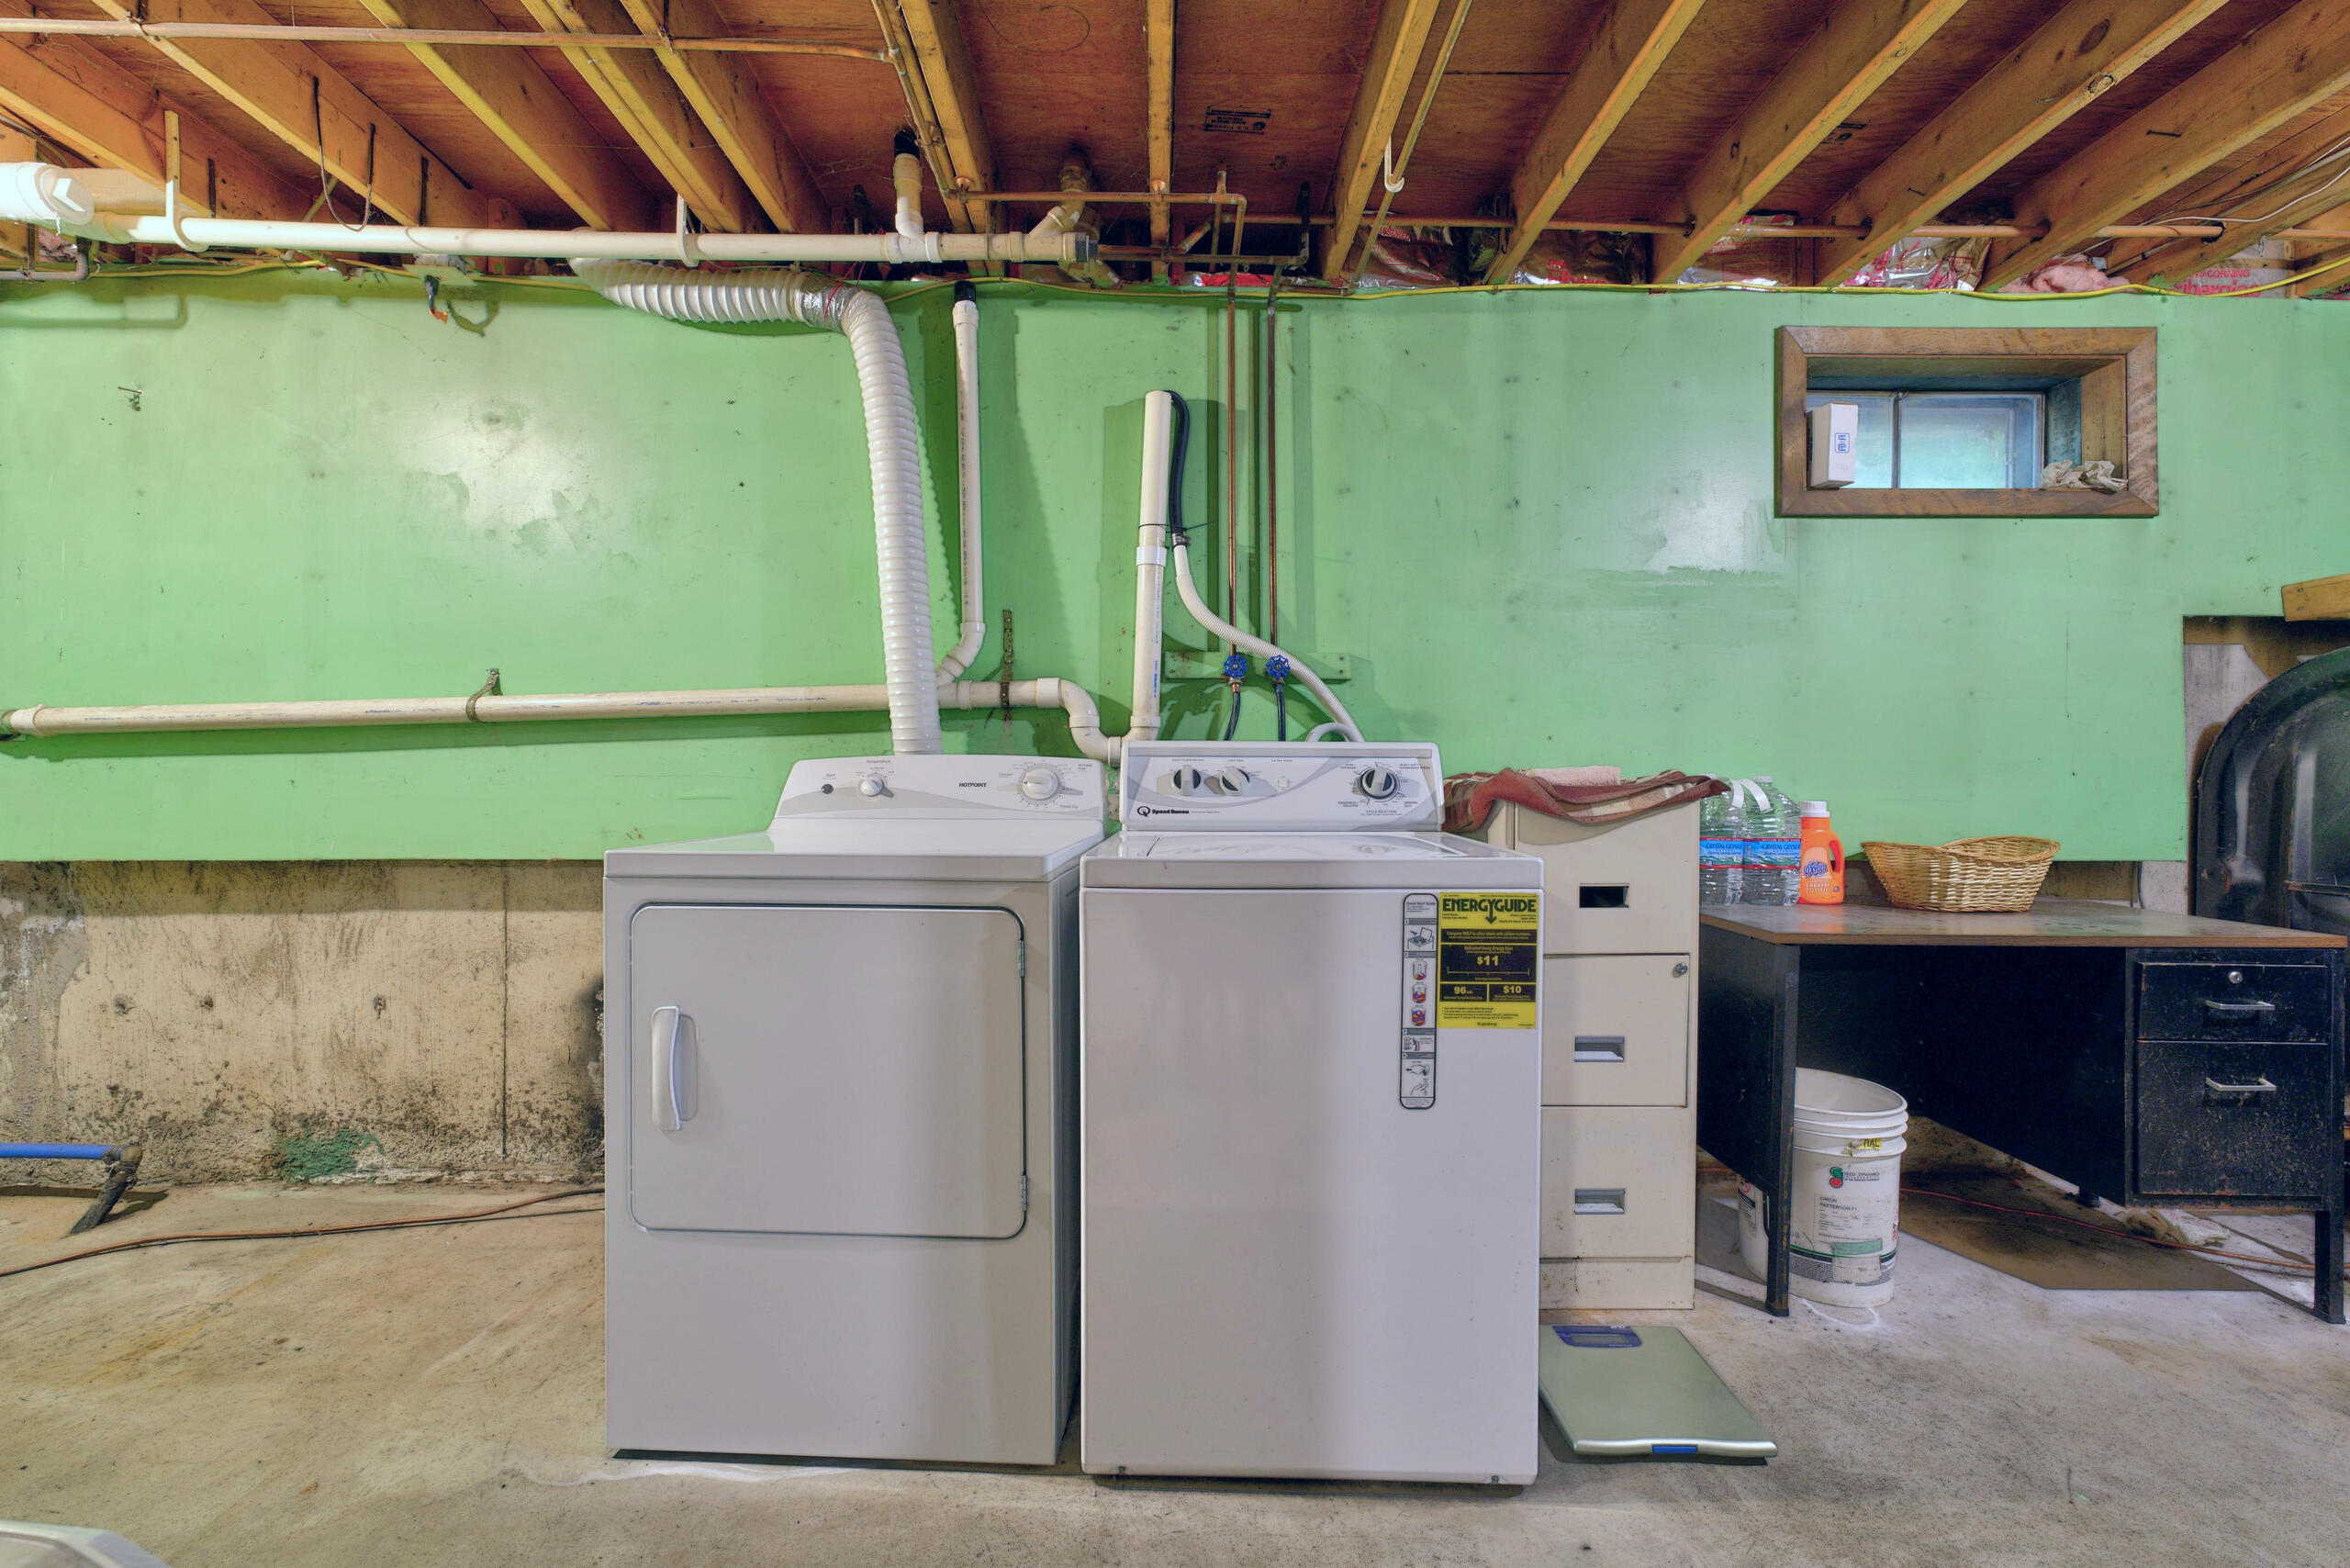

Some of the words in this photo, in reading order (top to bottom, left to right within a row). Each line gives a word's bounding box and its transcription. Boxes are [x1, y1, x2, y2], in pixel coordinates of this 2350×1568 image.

[1442, 898, 1537, 913] ENERGYGUIDE
[1476, 955, 1499, 966] $11
[1503, 985, 1522, 993] $10
